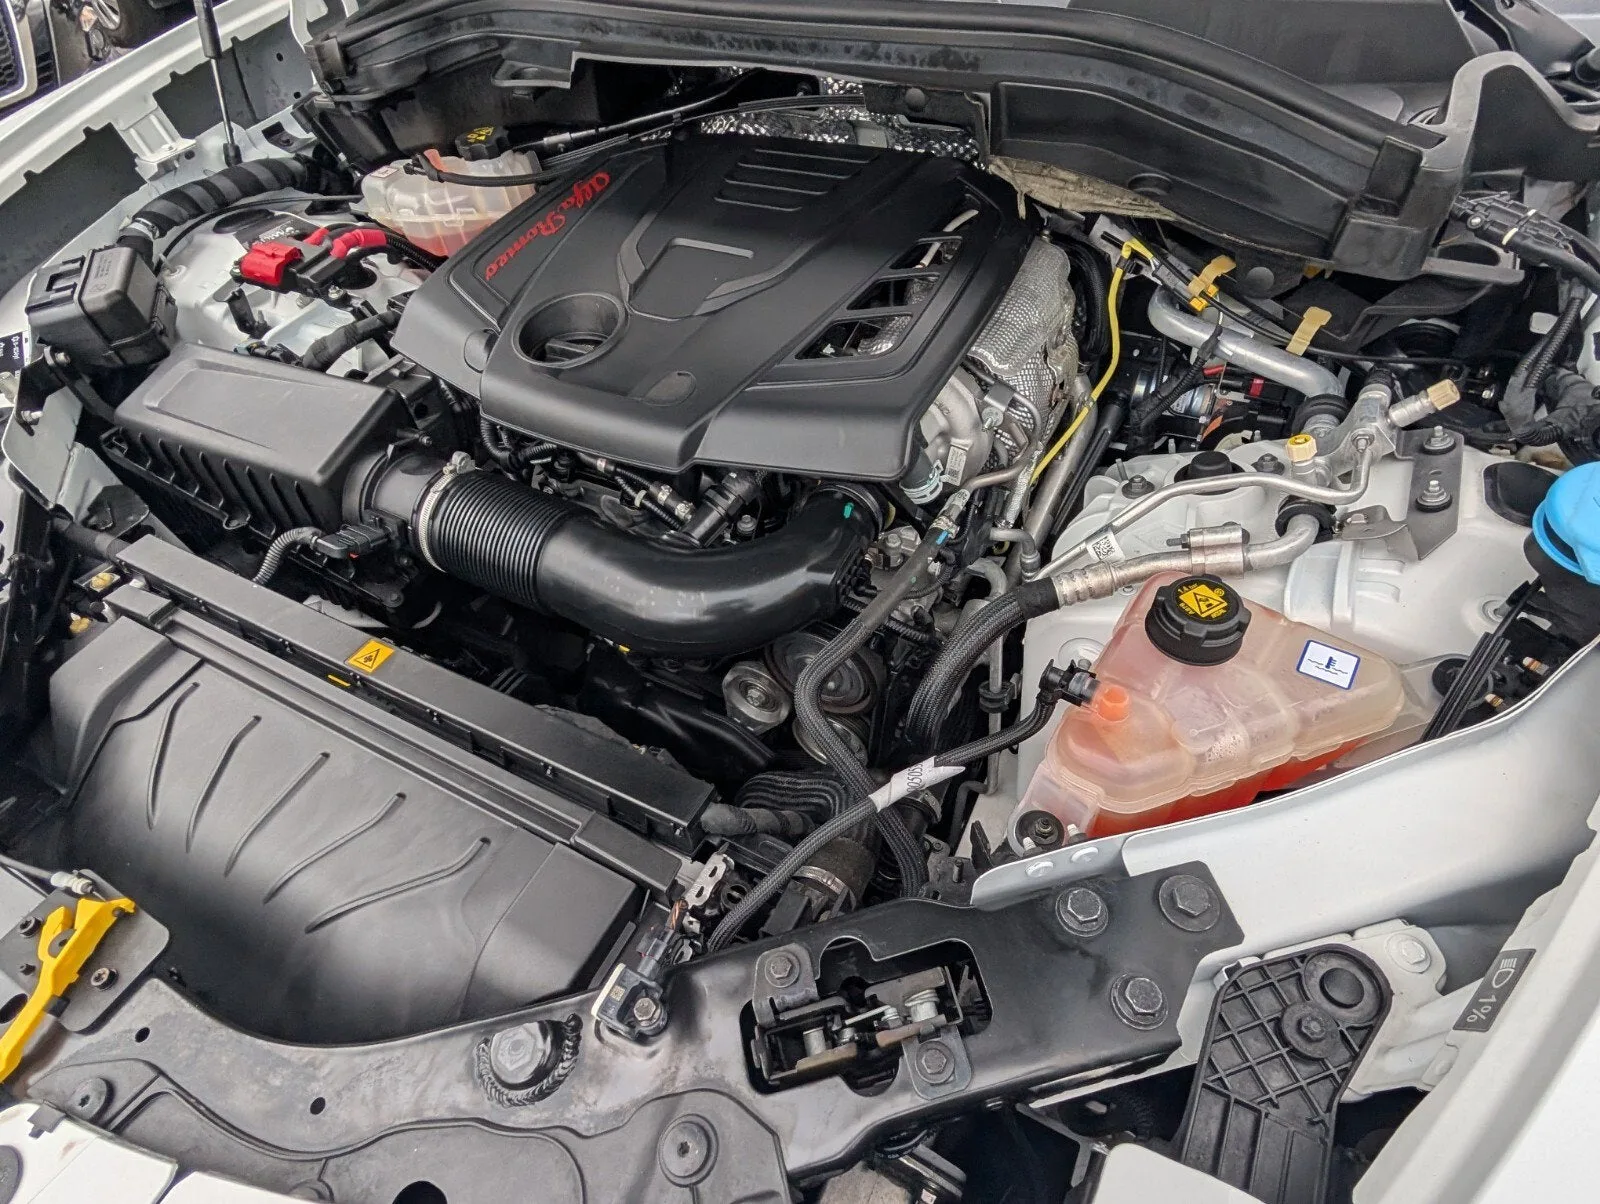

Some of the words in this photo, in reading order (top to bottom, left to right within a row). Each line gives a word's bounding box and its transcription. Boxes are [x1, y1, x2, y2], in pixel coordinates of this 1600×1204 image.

[559, 171, 611, 213] Alfa
[485, 211, 567, 282] Romeo
[1466, 994, 1498, 1023] 1%
